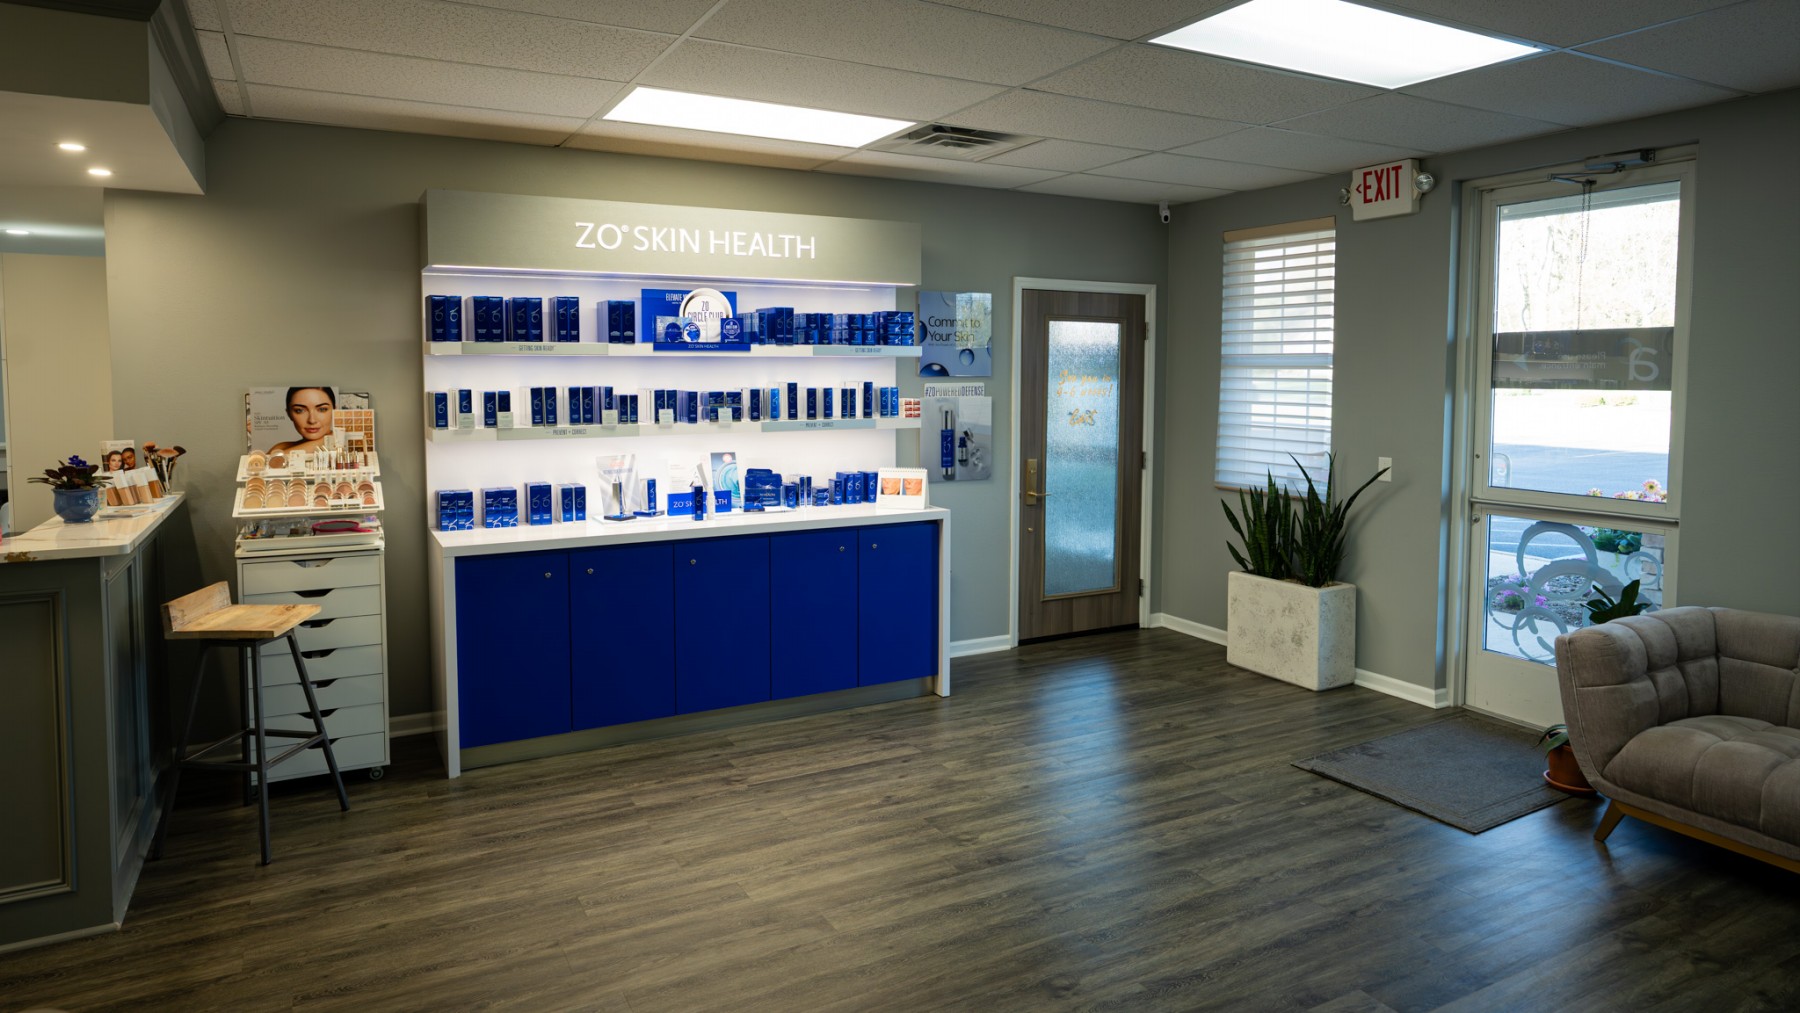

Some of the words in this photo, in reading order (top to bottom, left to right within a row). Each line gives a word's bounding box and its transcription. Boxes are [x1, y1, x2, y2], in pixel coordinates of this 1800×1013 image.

[1363, 165, 1402, 204] EXIT
[633, 225, 700, 253] SKIN
[708, 230, 816, 259] HEALTH
[701, 300, 710, 311] ZO
[928, 315, 968, 327] Commit
[970, 318, 981, 328] to
[928, 331, 953, 342] Your
[954, 331, 975, 342] Skin
